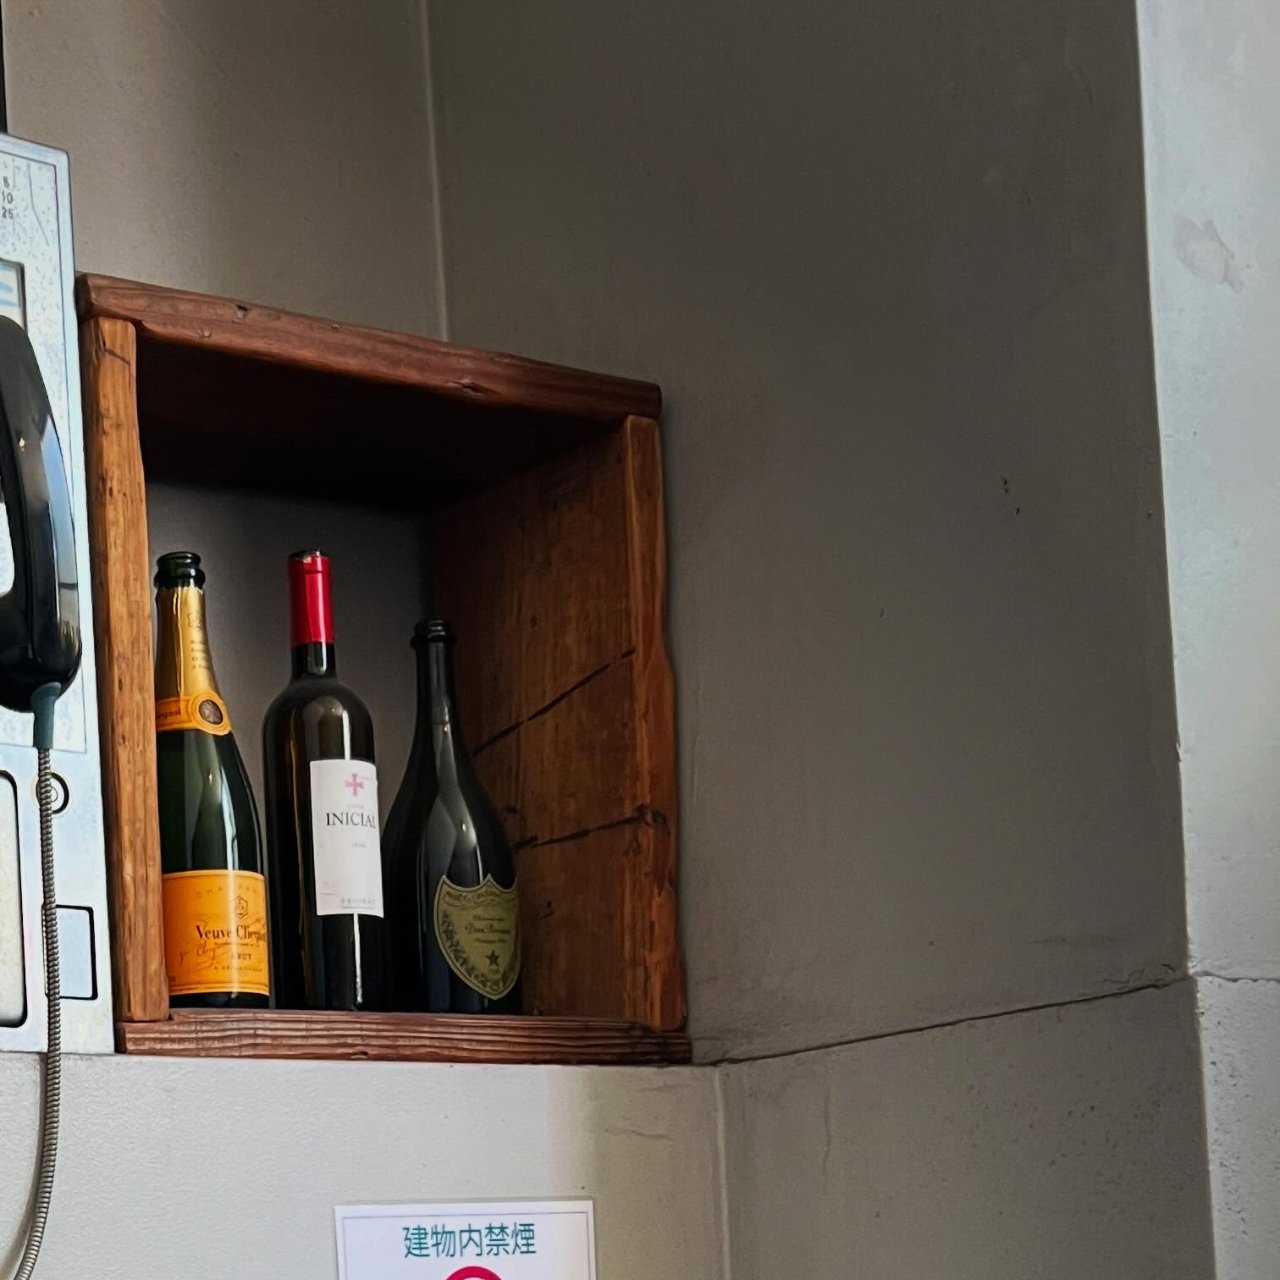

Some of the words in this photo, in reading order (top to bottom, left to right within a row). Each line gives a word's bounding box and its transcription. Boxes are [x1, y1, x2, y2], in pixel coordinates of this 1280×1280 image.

[2, 190, 14, 204] 10
[2, 206, 14, 219] 25
[325, 812, 377, 829] INICIAL
[402, 1222, 537, 1258] 建物内禁煙
